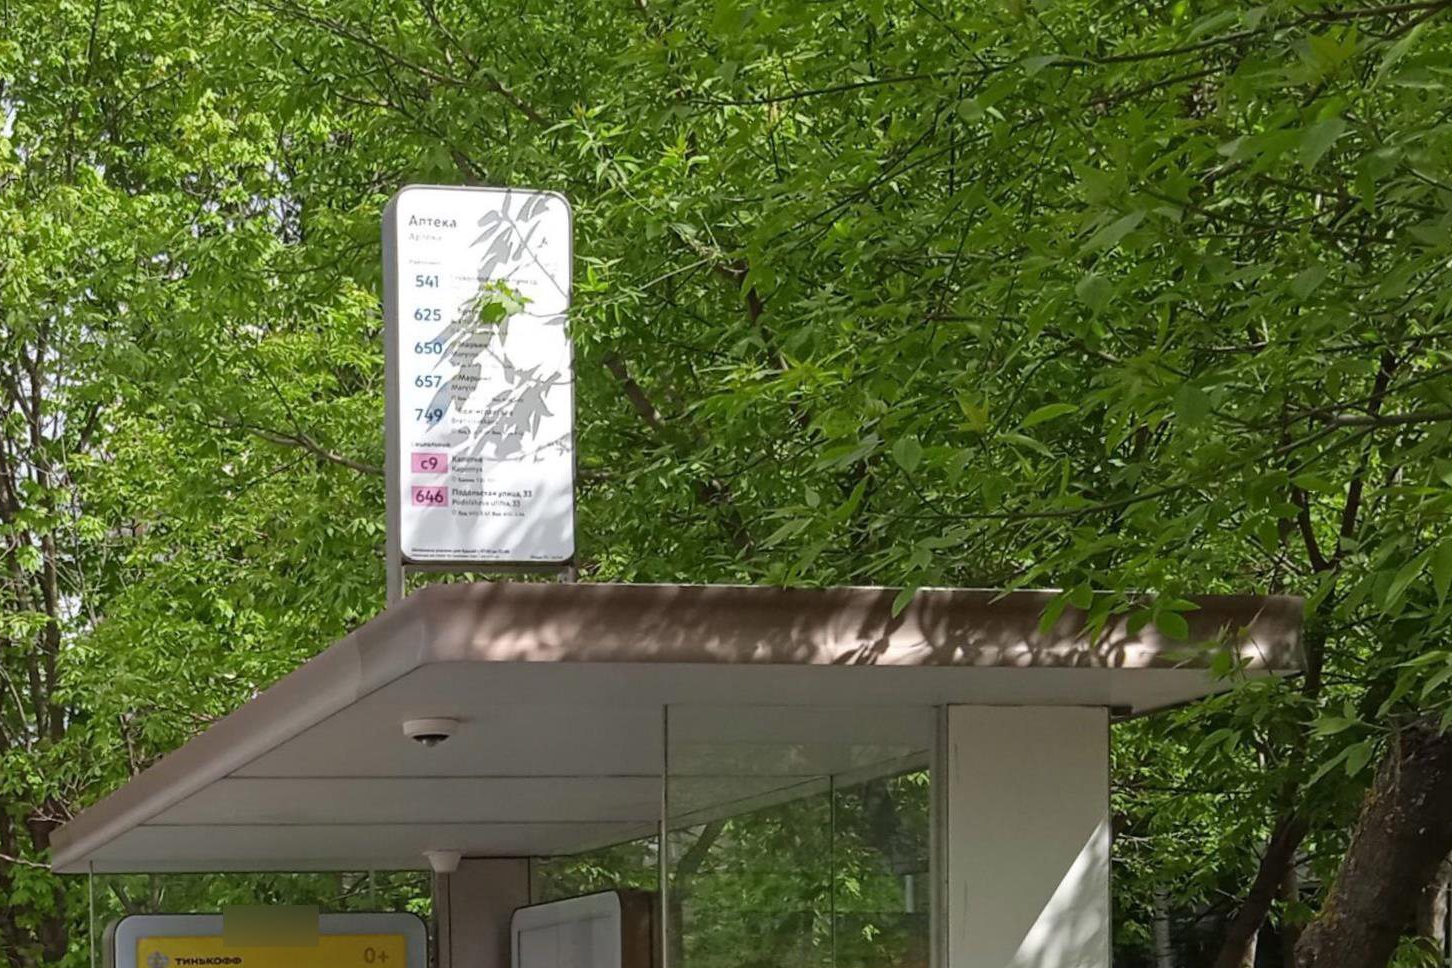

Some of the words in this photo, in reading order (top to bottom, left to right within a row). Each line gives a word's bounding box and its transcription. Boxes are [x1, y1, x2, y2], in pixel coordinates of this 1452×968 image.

[408, 214, 457, 229] Аптека
[415, 275, 439, 288] 541
[414, 308, 442, 321] 625
[414, 342, 443, 355] 650
[415, 375, 443, 388] 657
[414, 408, 443, 422] 749
[415, 490, 444, 504] 646
[174, 956, 242, 966] ТИНЬКОФФ
[363, 947, 389, 964] 0+
